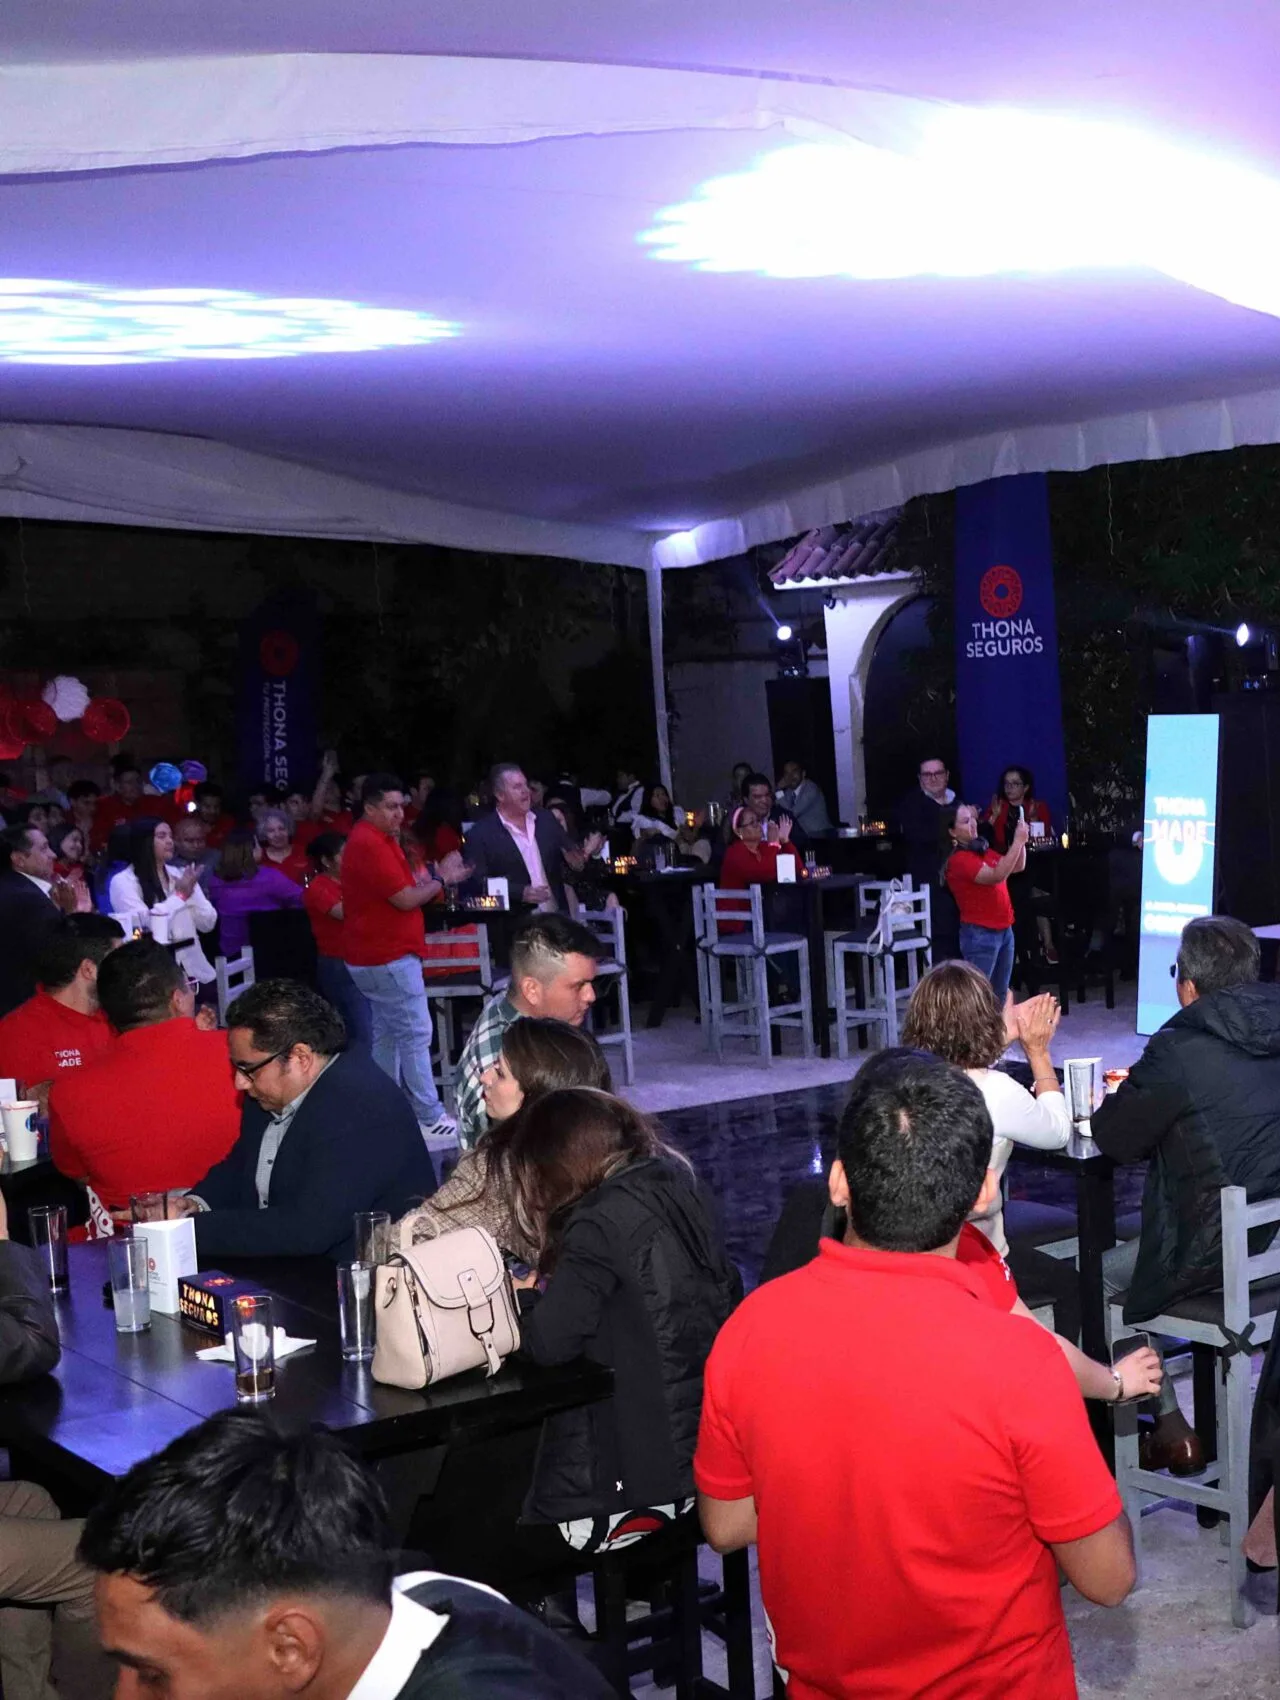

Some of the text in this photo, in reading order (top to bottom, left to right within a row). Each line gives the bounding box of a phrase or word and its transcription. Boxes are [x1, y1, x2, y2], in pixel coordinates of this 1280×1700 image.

[972, 618, 1035, 640] THONA
[966, 636, 1044, 658] SEGUROS
[273, 680, 288, 752] THONA
[1152, 819, 1208, 842] MADE
[58, 1057, 82, 1068] ADE
[183, 1283, 215, 1310] THONA
[179, 1297, 219, 1326] SEGUROS
